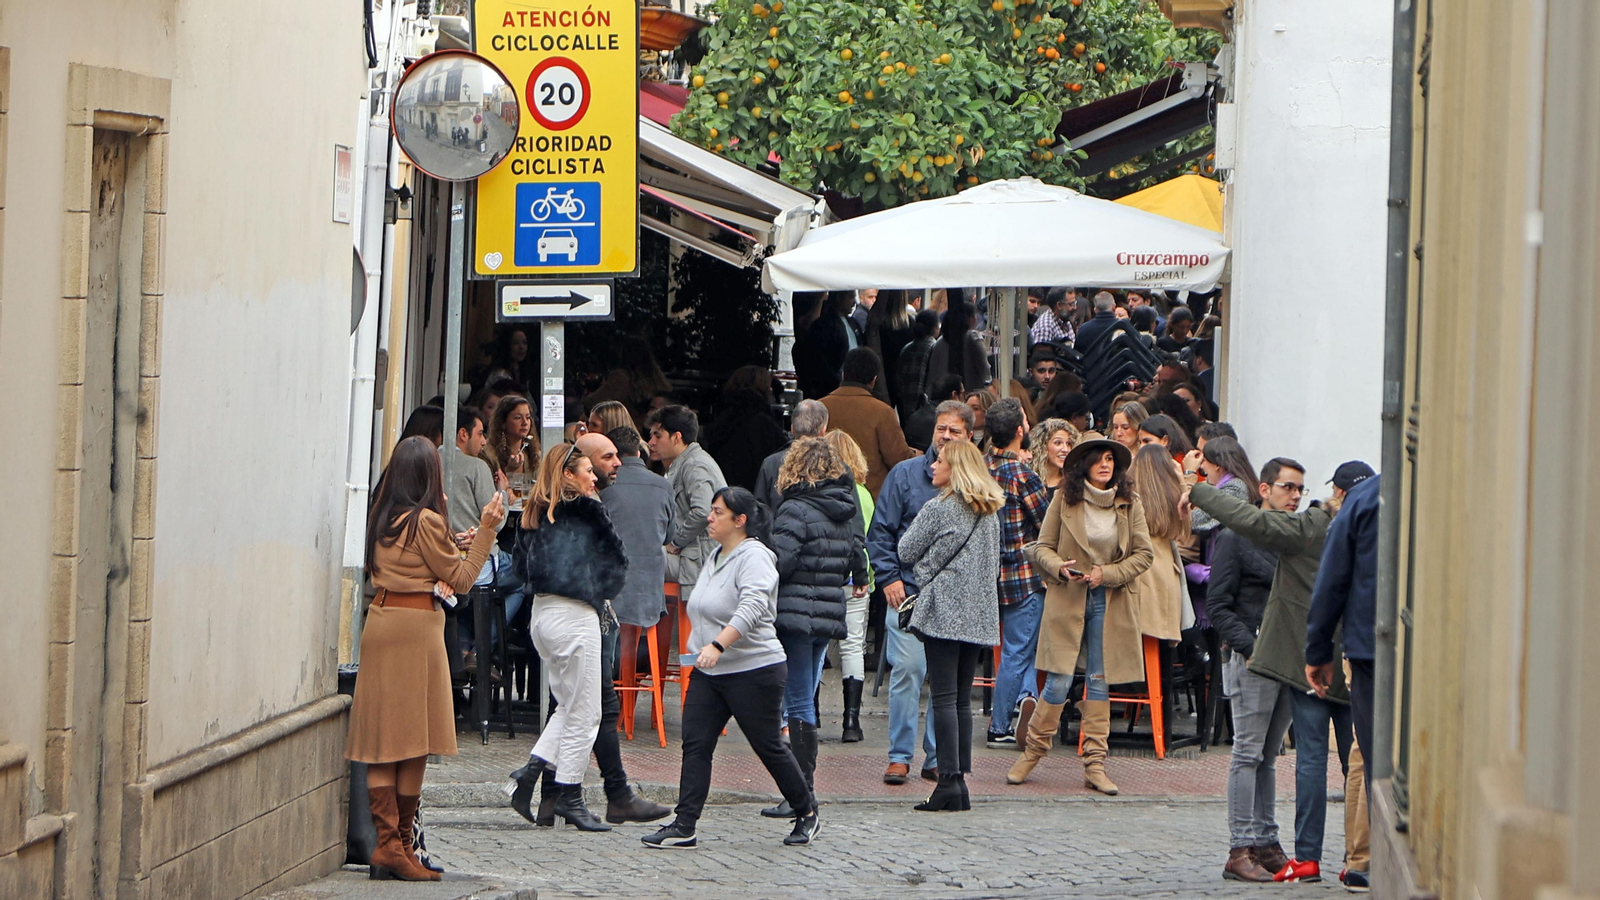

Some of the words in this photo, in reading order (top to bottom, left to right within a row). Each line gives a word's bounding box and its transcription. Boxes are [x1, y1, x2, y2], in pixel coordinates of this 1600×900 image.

[502, 4, 610, 27] ATENCIÓN
[491, 34, 619, 51] CICLOCALLE
[540, 82, 575, 106] 20
[515, 134, 612, 153] RIORIDAD
[511, 157, 605, 175] CICLISTA
[1116, 252, 1210, 268] Cruzcampo
[1133, 270, 1188, 281] ESPECIAL
